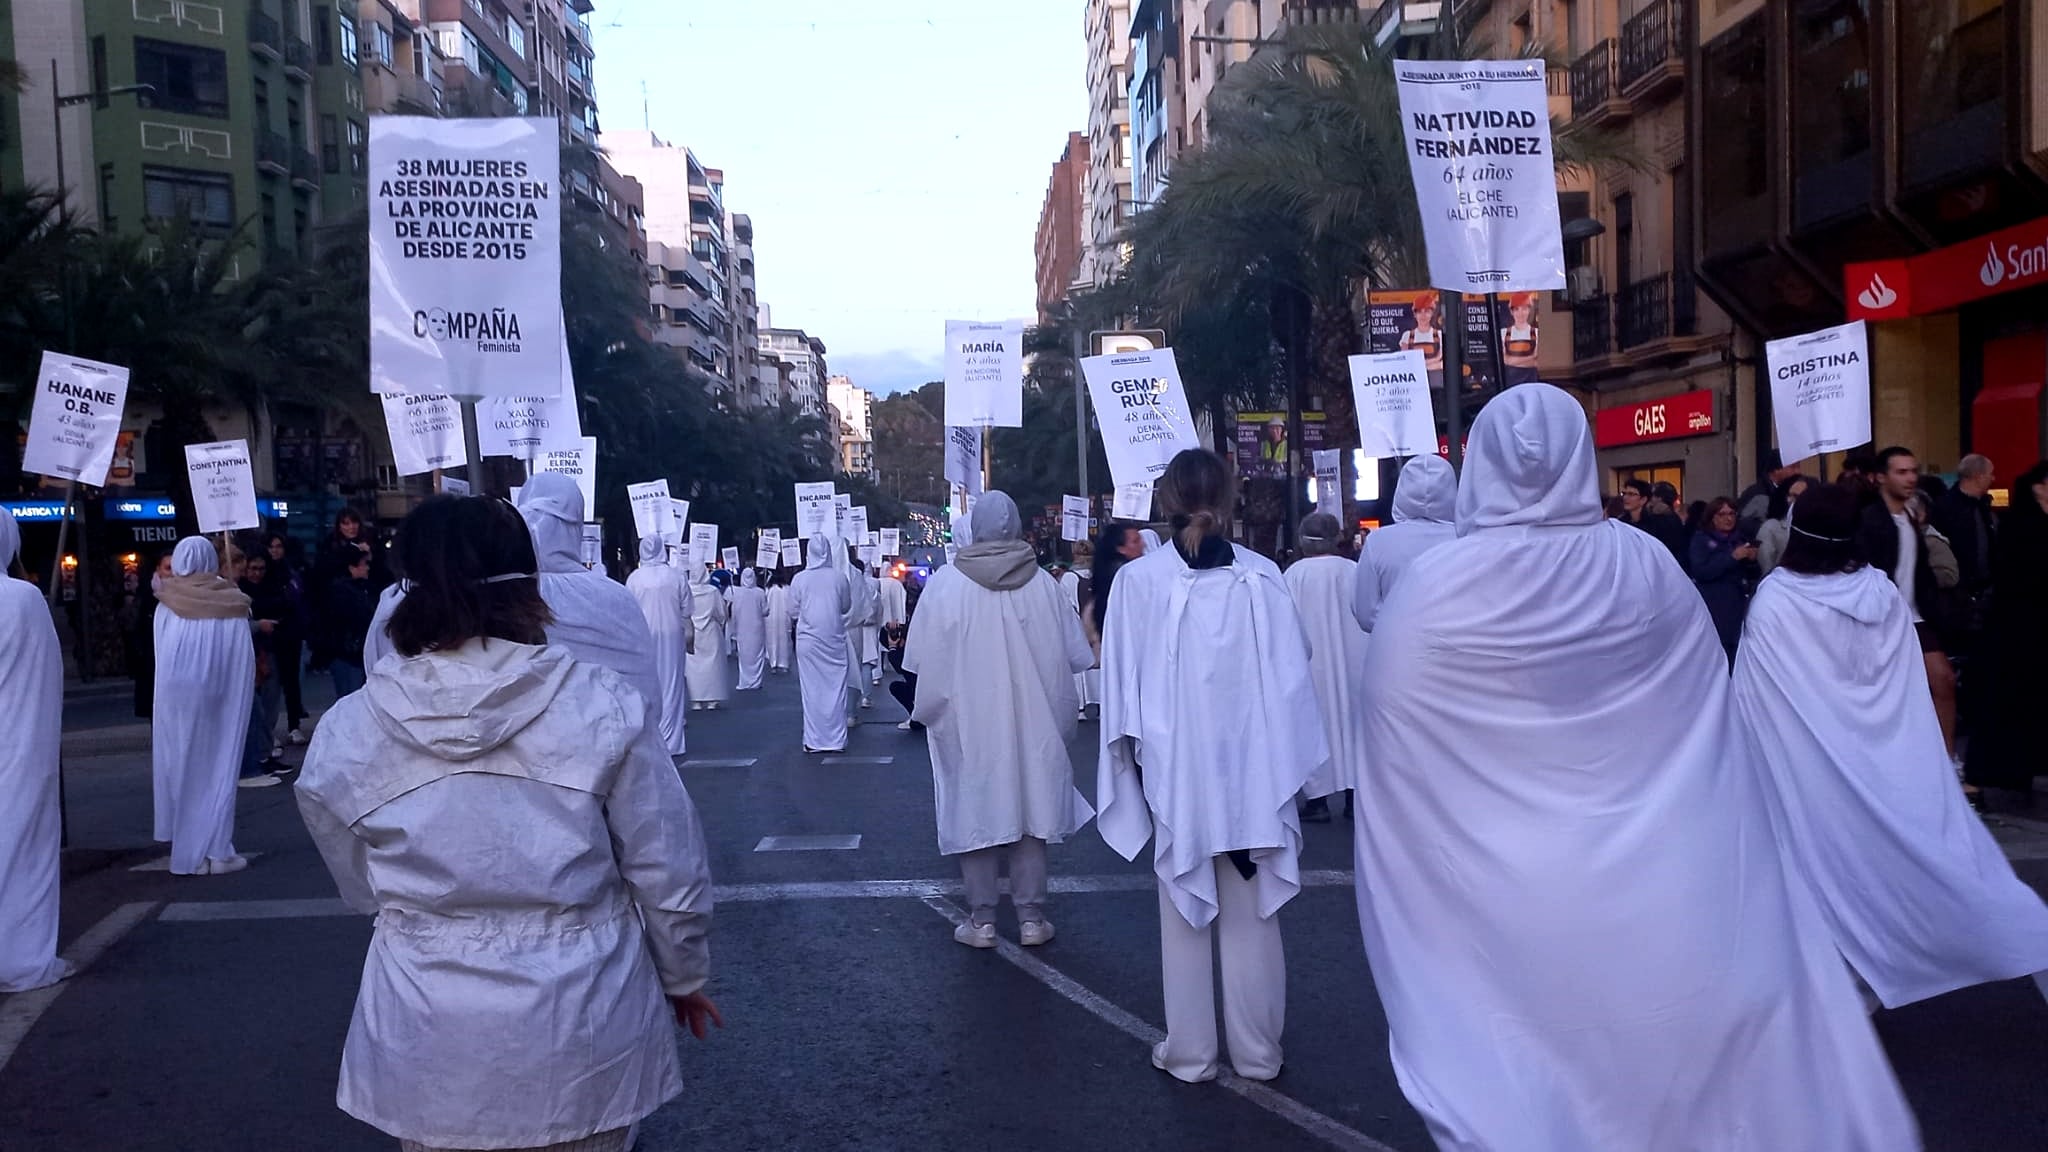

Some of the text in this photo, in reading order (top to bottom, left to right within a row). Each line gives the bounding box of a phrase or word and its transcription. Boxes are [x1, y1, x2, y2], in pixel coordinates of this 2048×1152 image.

[1447, 70, 1476, 81] JUNTO
[1496, 69, 1539, 79] HERMANA
[1413, 110, 1536, 132] NATIVIDAD
[1415, 132, 1542, 159] FERNÁNDEZ
[396, 159, 528, 178] 38 MUJERES
[1443, 162, 1514, 184] 64 años
[379, 180, 549, 200] ASESINADAS EN
[1459, 189, 1503, 205] ELCHE
[388, 200, 539, 220] LA PROVINCIA
[1447, 205, 1518, 221] (ALICANTE)
[395, 221, 534, 240] DE ALICANTE
[403, 241, 527, 260] DESDE 2015
[2008, 235, 2048, 280] San
[1467, 306, 1488, 315] CONSI
[477, 340, 521, 353] Feminista
[962, 340, 1005, 354] MARÍA
[1777, 351, 1860, 380] CRISTINA
[1111, 377, 1160, 394] GEMA
[1363, 373, 1417, 387] JOHANA
[48, 380, 117, 405] HANANE
[64, 398, 94, 416] O.B.
[495, 419, 550, 431] (ALICANTE)
[1124, 411, 1139, 423] 48
[1634, 404, 1666, 436] GAES
[1128, 431, 1175, 445] (ALICANTE)
[190, 458, 248, 471] CONSTANTINA
[550, 459, 578, 468] ELENA
[12, 506, 52, 517] PLÁSTICA
[52, 507, 59, 516] Y
[132, 526, 177, 542] TIEND
